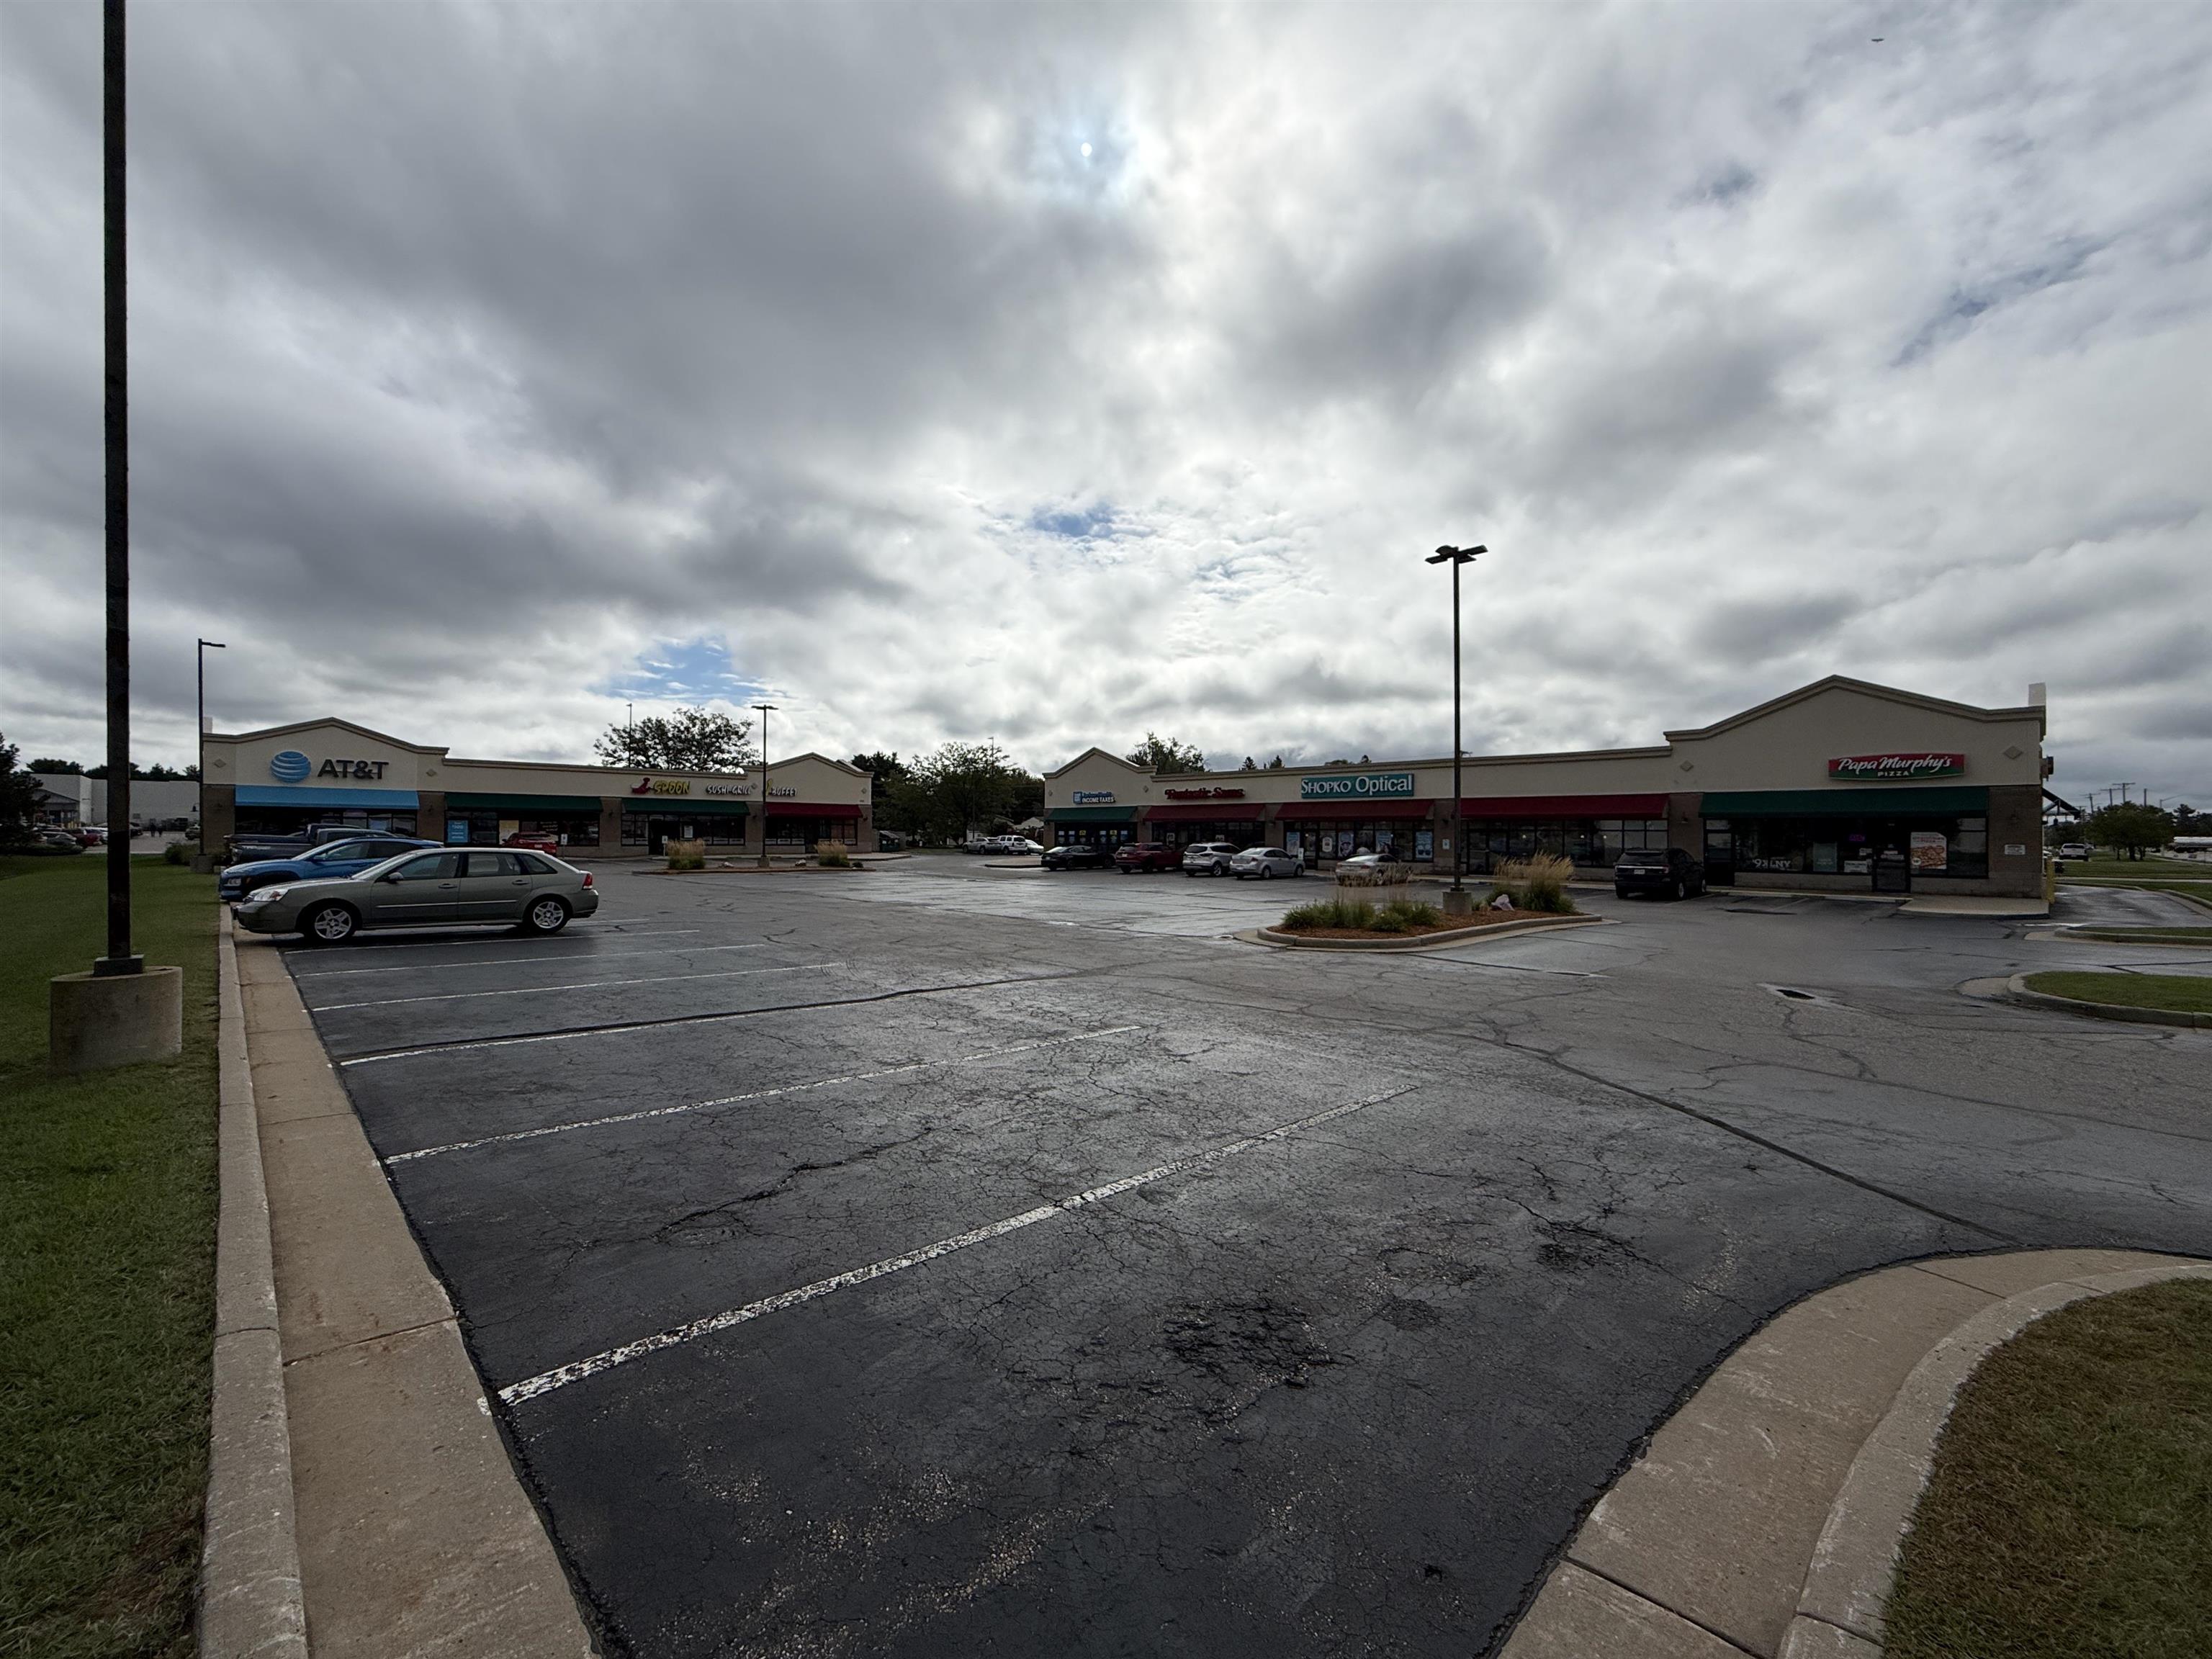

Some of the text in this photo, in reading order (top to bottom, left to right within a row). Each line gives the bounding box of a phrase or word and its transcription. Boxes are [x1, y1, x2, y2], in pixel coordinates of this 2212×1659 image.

[318, 759, 389, 779] AT&T
[1838, 755, 1952, 775] Papa Murphy's
[654, 781, 691, 795] SPOON
[771, 786, 797, 796] BUFFET
[1301, 775, 1412, 796] SHOPKO Optical
